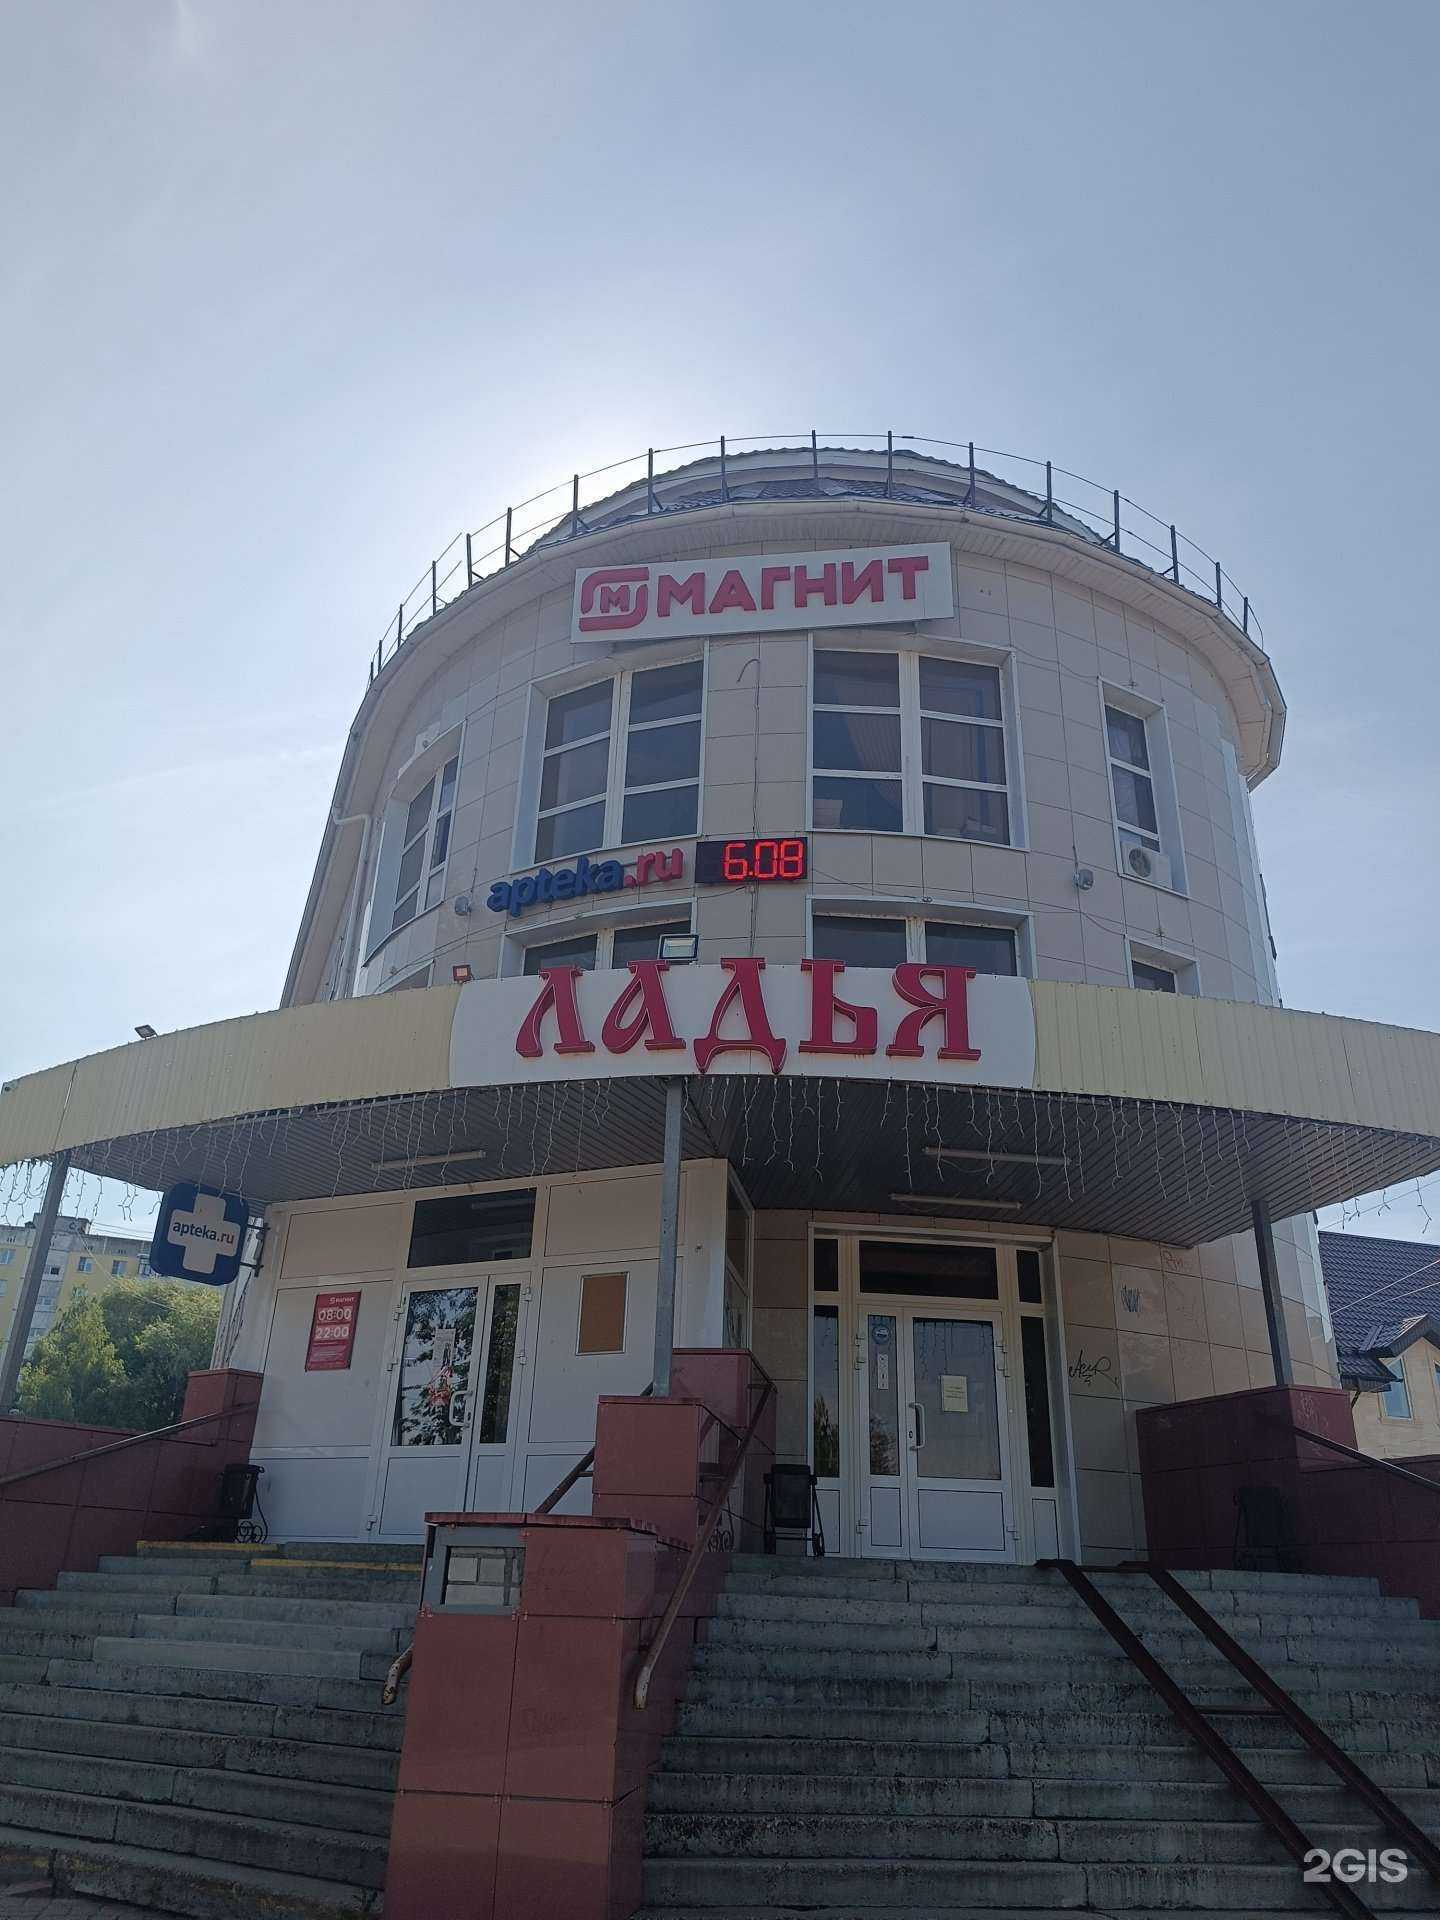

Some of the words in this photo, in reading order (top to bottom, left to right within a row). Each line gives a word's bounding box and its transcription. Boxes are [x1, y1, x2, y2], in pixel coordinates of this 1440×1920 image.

[657, 555, 929, 617] МАГНИТ
[724, 839, 803, 880] 6.08
[487, 847, 683, 917] apteka.ru
[516, 957, 981, 1074] ЛАДЬЯ
[173, 1222, 234, 1243] apteka.ru
[316, 1326, 349, 1339] 22:00
[319, 1308, 352, 1321] 08:00
